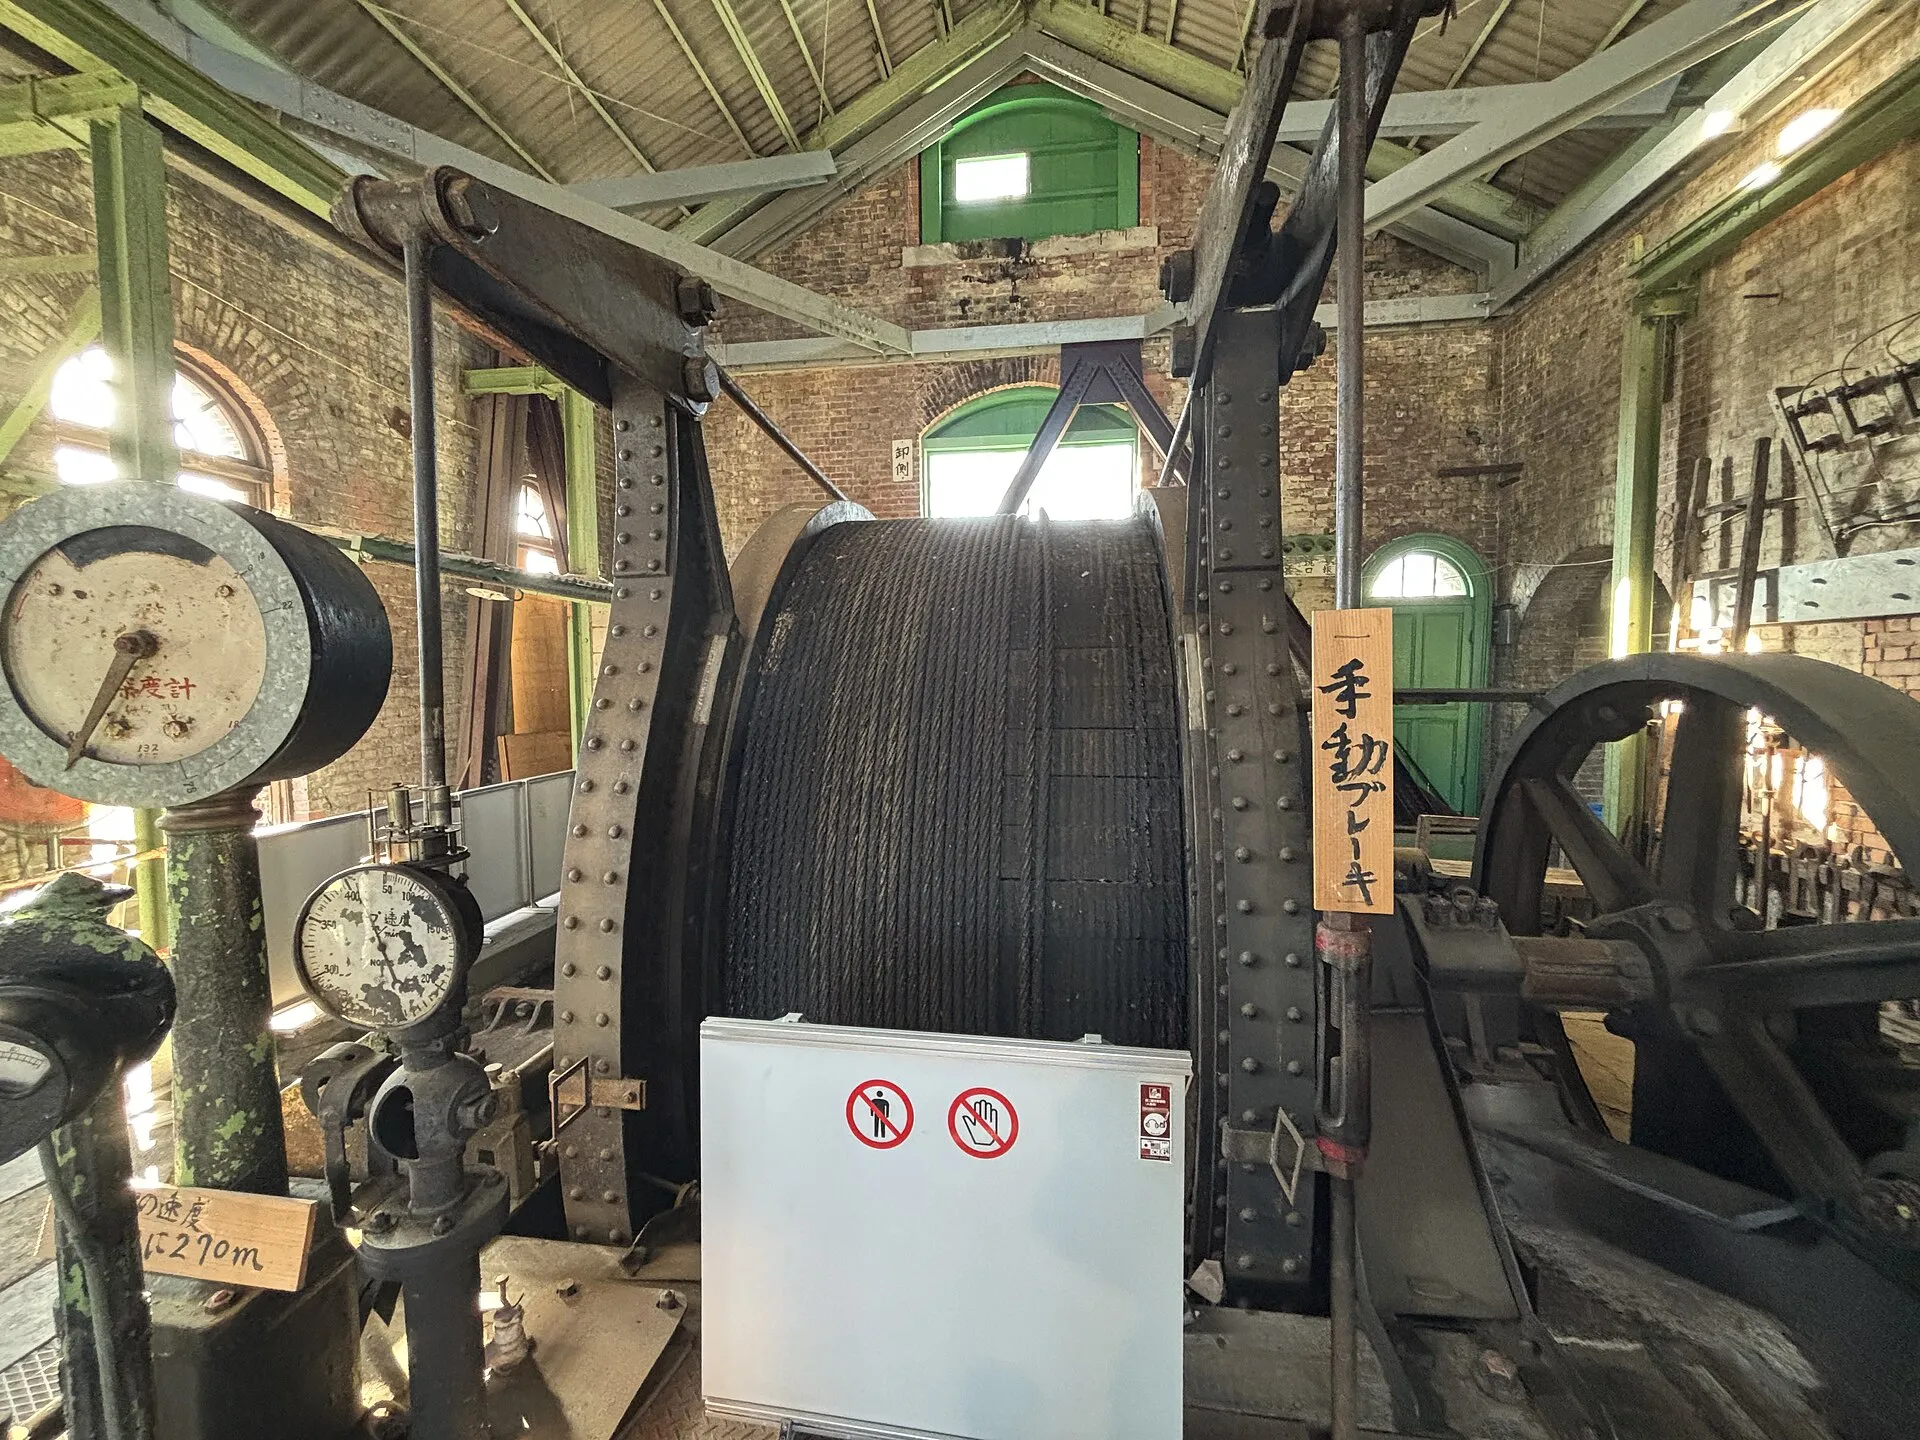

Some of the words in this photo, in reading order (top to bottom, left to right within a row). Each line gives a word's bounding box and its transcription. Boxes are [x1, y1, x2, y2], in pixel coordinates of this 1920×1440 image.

[895, 446, 910, 477] 卸側
[382, 885, 393, 894] 50
[136, 1190, 206, 1233] の速度
